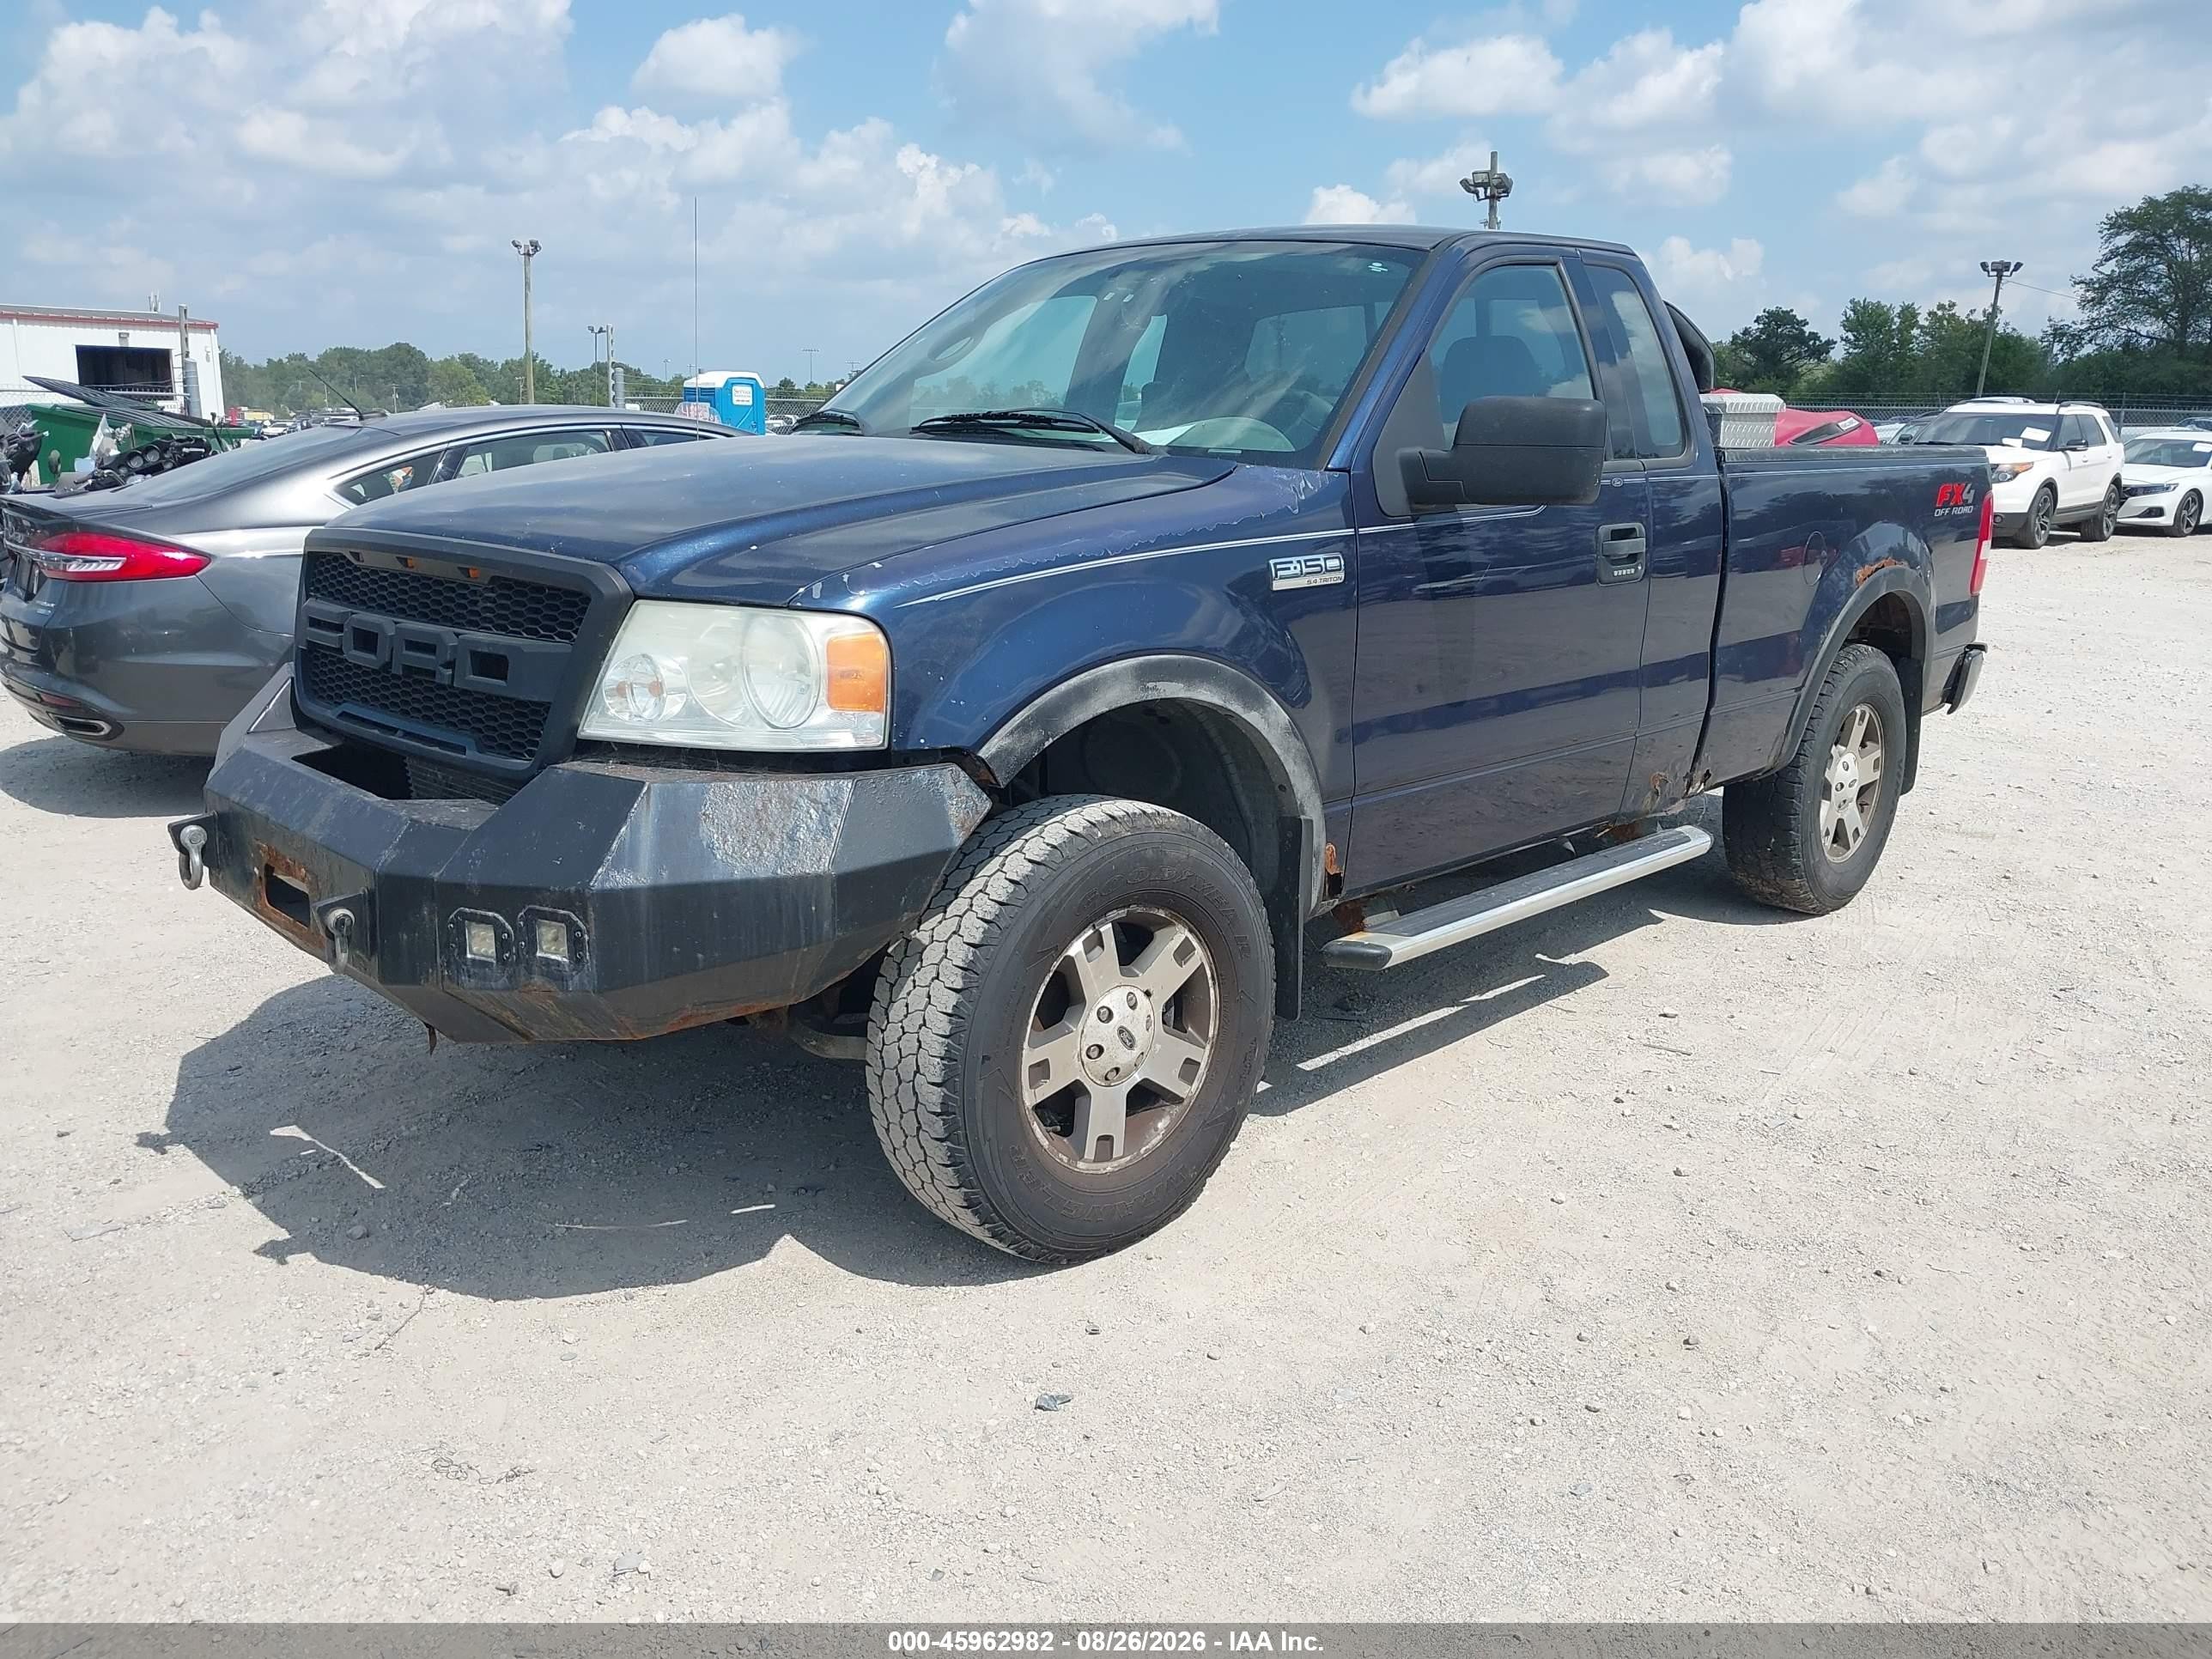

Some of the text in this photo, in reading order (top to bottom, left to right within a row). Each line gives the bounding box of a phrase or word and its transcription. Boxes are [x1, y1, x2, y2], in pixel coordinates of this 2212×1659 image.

[1936, 483, 1975, 507] FX4
[1934, 505, 1973, 517] OFF ROAD
[1318, 575, 1343, 584] TRITON
[301, 597, 550, 701] FORD
[1009, 1145, 1198, 1224] WRANGLER
